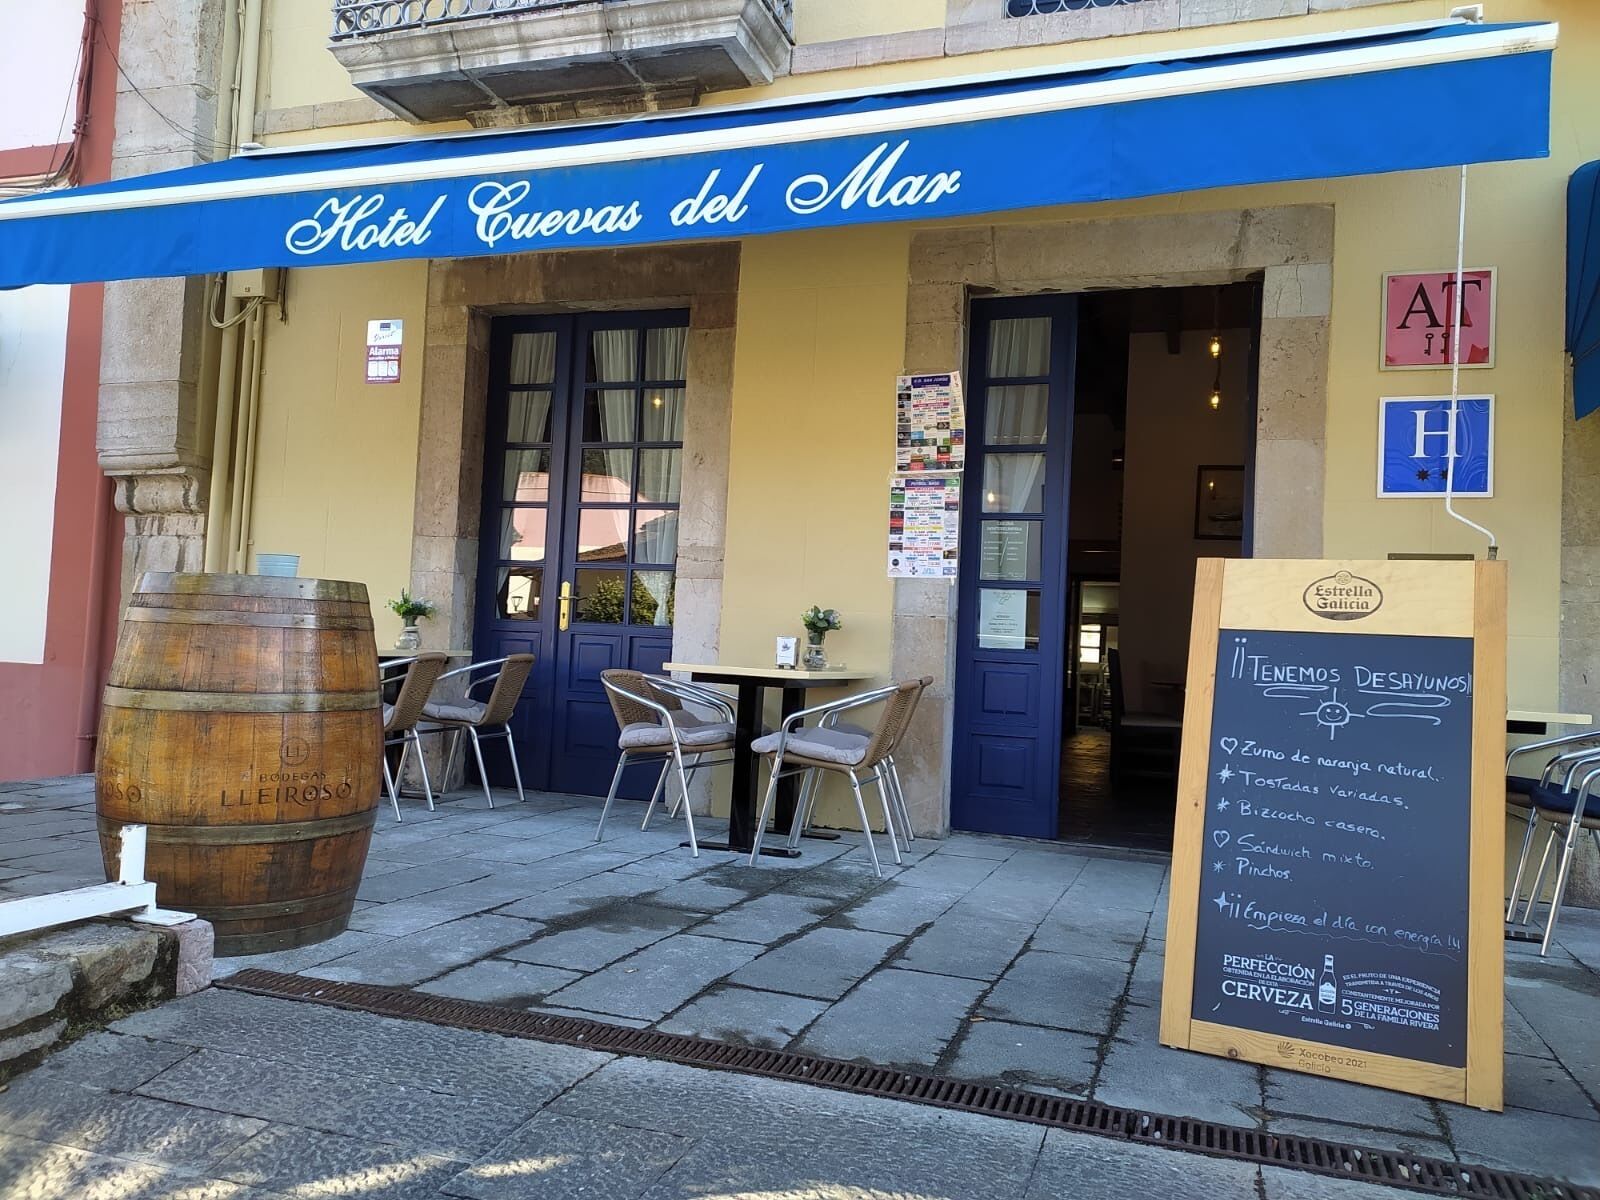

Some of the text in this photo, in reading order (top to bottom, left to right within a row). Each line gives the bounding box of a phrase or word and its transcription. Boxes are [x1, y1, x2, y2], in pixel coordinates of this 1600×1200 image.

[286, 140, 962, 255] Hotel Cuevas del Mar
[1396, 279, 1482, 330] AT
[368, 346, 400, 356] Alarma
[1409, 409, 1464, 459] H
[1314, 584, 1373, 598] Estrella
[1316, 597, 1370, 611] Galicia
[1240, 741, 1285, 760] Zumo
[1290, 749, 1311, 764] de
[1317, 757, 1372, 776] naranja
[259, 771, 327, 783] BODEGAS
[220, 782, 352, 807] LLEIROSO
[1237, 799, 1386, 840] Bizcocho casero.
[1237, 833, 1375, 870] Sándwich mixto.
[1235, 856, 1293, 882] Pinchos.
[1312, 911, 1328, 927] el
[1332, 913, 1359, 931] día
[1365, 924, 1388, 936] con
[1393, 929, 1442, 952] energía
[1223, 954, 1316, 980] PERFECCIÓN
[1264, 953, 1274, 961] LA
[1222, 967, 1253, 977] OBTENIDA
[1270, 974, 1315, 987] ELABORACIÓN
[1221, 980, 1314, 1010] CERVEZA
[1427, 1002, 1440, 1010] POR
[1301, 1015, 1345, 1029] Estrella Galicia
[1340, 998, 1440, 1024] 5 GENERACIONES
[1354, 1010, 1440, 1031] DE LA FAMILIA RIVERA
[1298, 1059, 1332, 1074] Galicia
[1299, 1047, 1368, 1069] Xacobeo 2021
